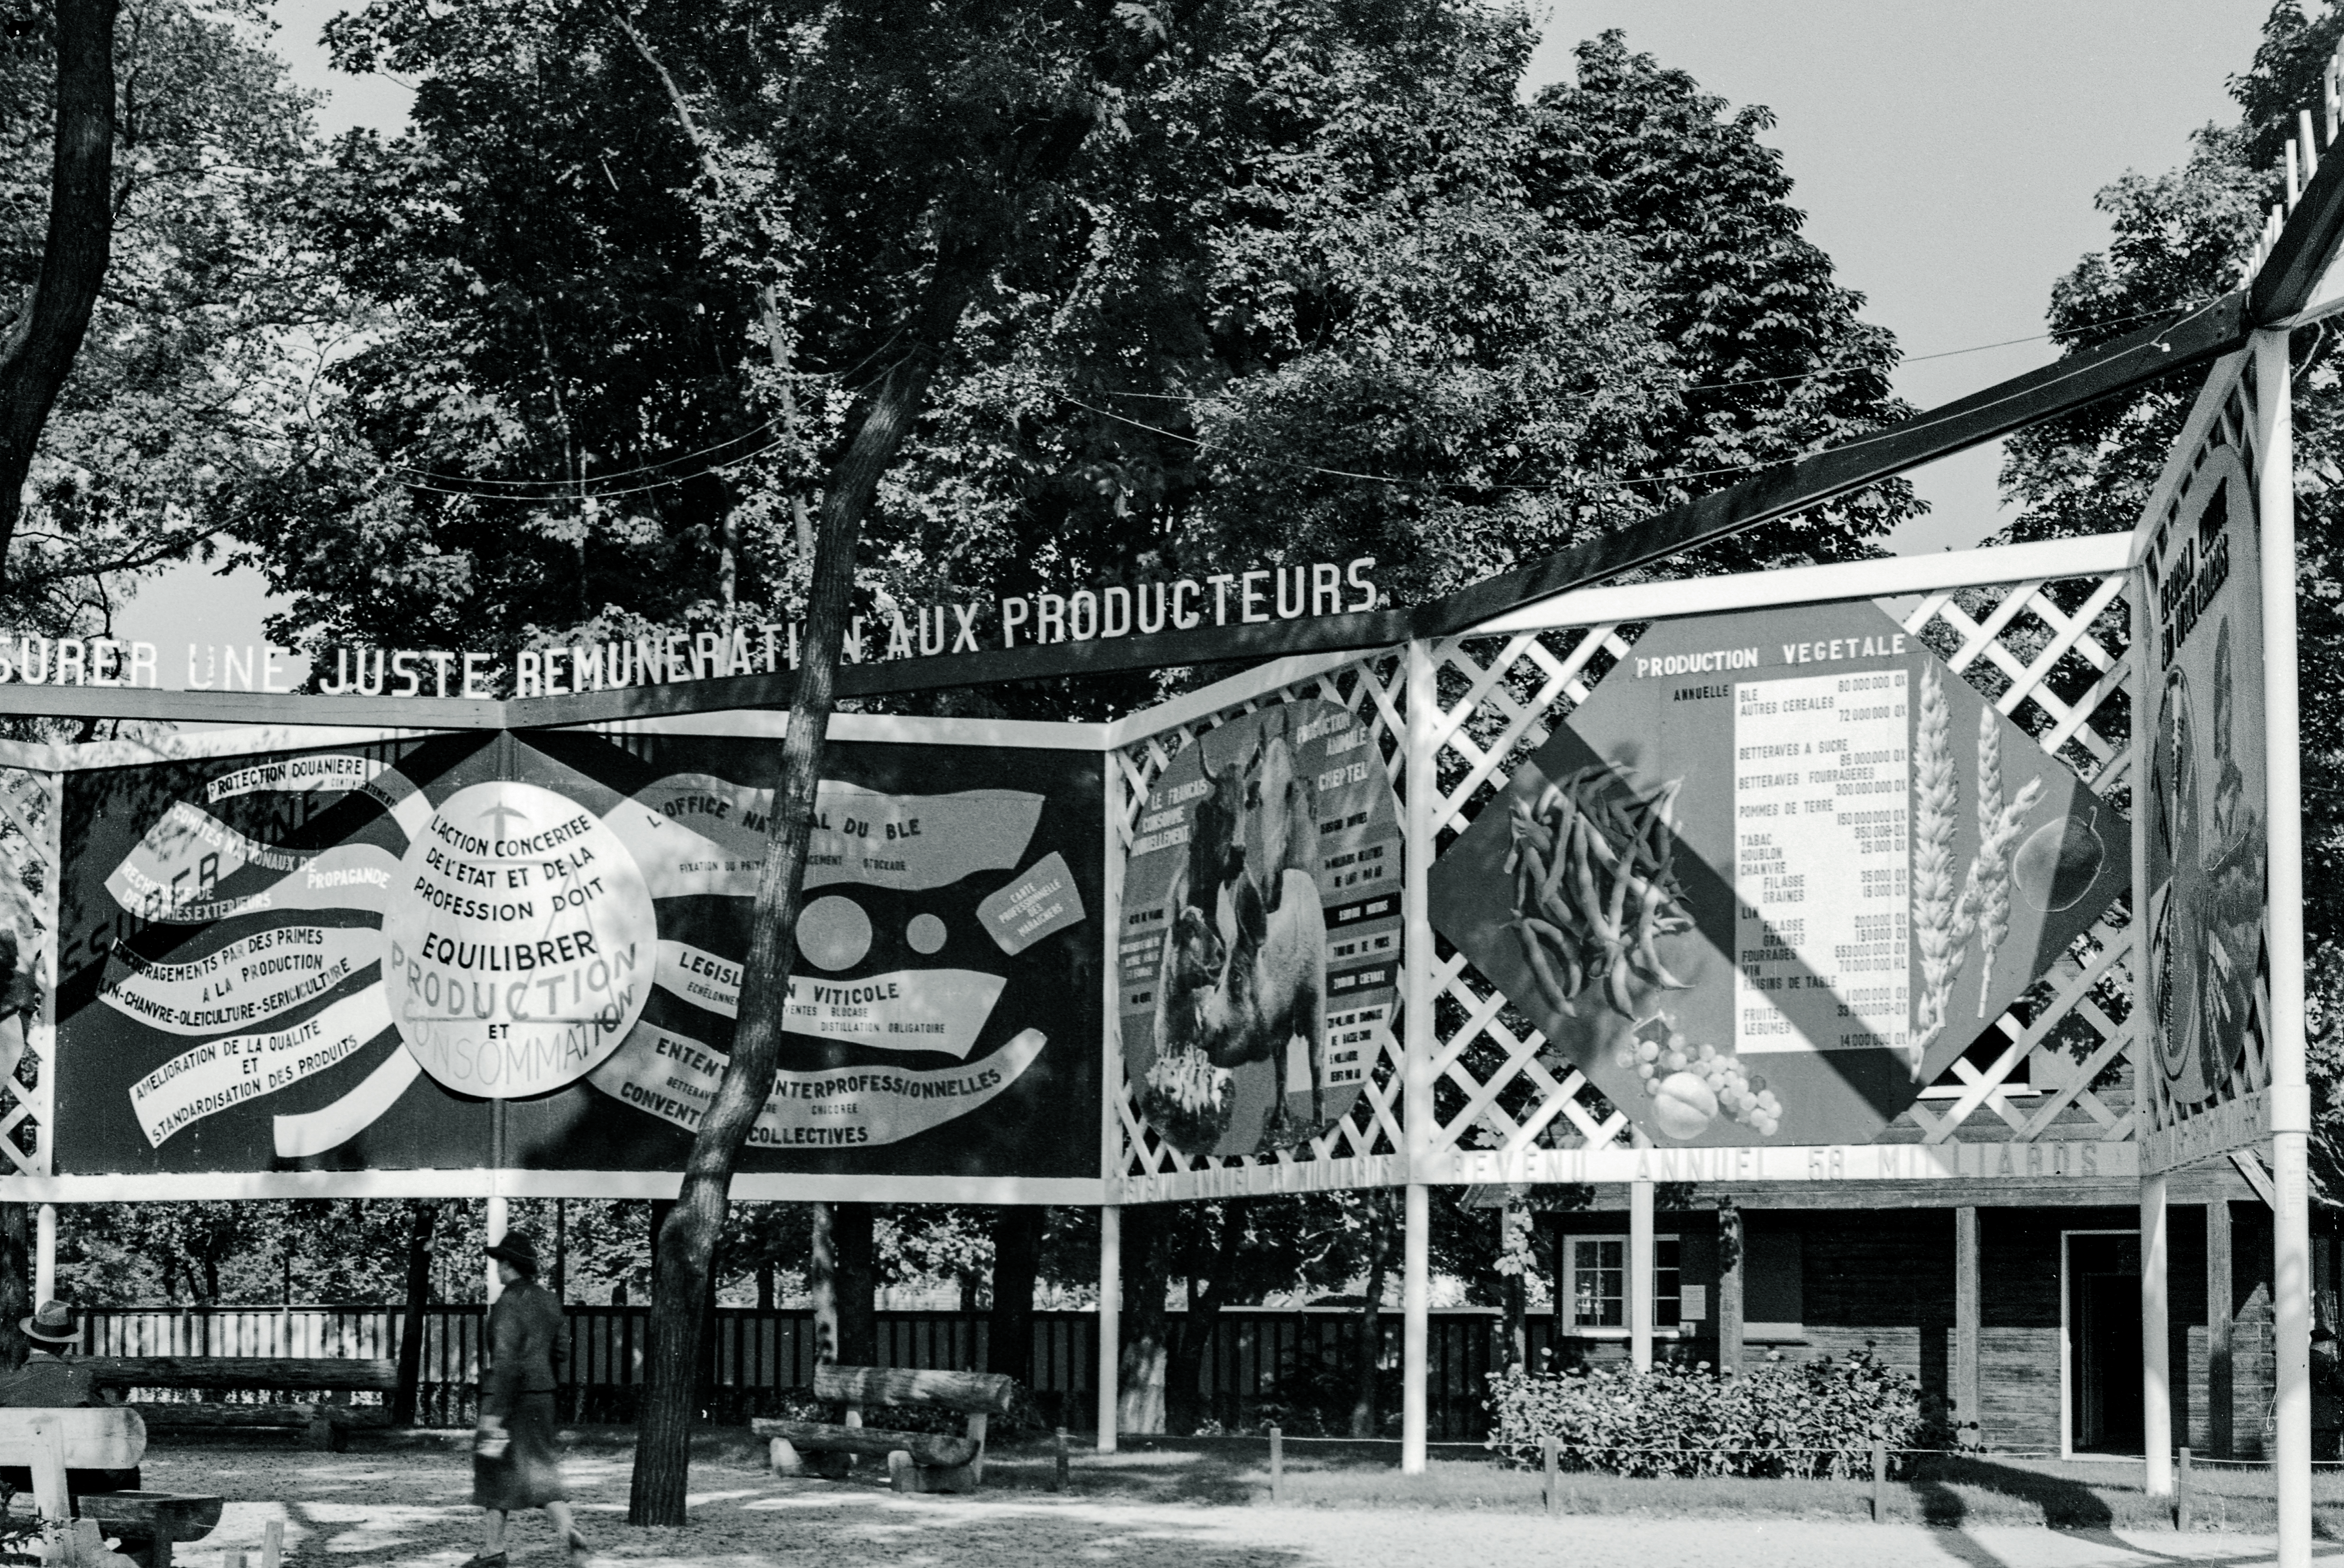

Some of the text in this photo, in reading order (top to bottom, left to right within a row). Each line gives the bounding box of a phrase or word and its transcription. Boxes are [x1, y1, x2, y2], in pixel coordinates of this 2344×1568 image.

[189, 642, 290, 692] UNE
[319, 648, 490, 699] JUSTE
[516, 615, 862, 699] REMUNERATIN
[887, 603, 979, 660] AUX
[1002, 558, 1376, 648] PRODUCTEURS
[1636, 633, 1906, 679] PRODUCTION VEGETALE
[1673, 685, 1729, 702] ANNUELLE
[1740, 688, 1758, 703] BLE
[1740, 696, 1834, 716] AUTRES CEREALES
[1739, 739, 1848, 760] BETTERAVES A SUCRE
[209, 759, 362, 798] PROTECTION DOUANIERE
[1318, 761, 1368, 792] CHEPTEL
[1739, 767, 1875, 789] BETTERAVES FOURRAGERES
[646, 795, 730, 828] L'OFFICE
[843, 817, 869, 838] DU
[886, 818, 921, 840] BLE
[1740, 799, 1834, 818] POMMES DE TERRE
[173, 806, 317, 872] COMITES NATIONAUX DE
[430, 814, 592, 857] L'ACTION CONCERTEE
[1741, 833, 1772, 846] TABAC
[1740, 847, 1782, 862] HOUBLON
[307, 867, 392, 889] PROPAGANDE
[425, 846, 596, 889] DE L'ETAT ET DE LA
[679, 861, 718, 873] FIXATION
[724, 861, 735, 871] DU
[1740, 861, 1786, 876] CHANVRE
[1764, 874, 1805, 889] FILASSE
[197, 888, 214, 901] DE
[414, 876, 605, 921] PROFESSION DOIT
[1763, 889, 1804, 904] GRAINES
[193, 893, 272, 921] EXTERIEURS
[1742, 906, 1759, 919] LIN
[1763, 918, 1805, 932] FILASSE
[422, 930, 598, 972] EQUILIBRER
[1763, 933, 1805, 947] GRAINES
[112, 928, 323, 982] ENCOURAGEMENTS PAR DES PRIMES
[1742, 948, 1797, 962] FOURRAGES
[202, 954, 323, 1003] A LA PRODUCTION
[391, 941, 636, 1021] PRODUCTION
[1742, 964, 1760, 977] VIN
[814, 983, 899, 1005] VITICOLE
[1743, 975, 1837, 991] RAISINS DE TABLE
[1743, 1007, 1780, 1021] FRUITS
[402, 982, 634, 1085] CONSOMMATION
[488, 1024, 510, 1039] ET
[821, 1022, 945, 1034] DISTILLATION OBLIGATOIRE
[1744, 1022, 1791, 1035] LEGUMES
[136, 1020, 321, 1101] AMELIORATION DE LA QUALITE
[242, 1057, 258, 1074] ET
[656, 1037, 1002, 1099] ENTENT NTERPROFESSIONNELLES
[152, 1034, 358, 1142] STANDARDISATION DES PRODUITS
[666, 1077, 711, 1100] BETTERAV
[620, 1082, 868, 1145] CONVENT COLLECTIVES
[1451, 1151, 1587, 1183] REVENU
[1638, 1147, 1776, 1181] ANNUEL
[1879, 1143, 2097, 1179] MILLIARDS
